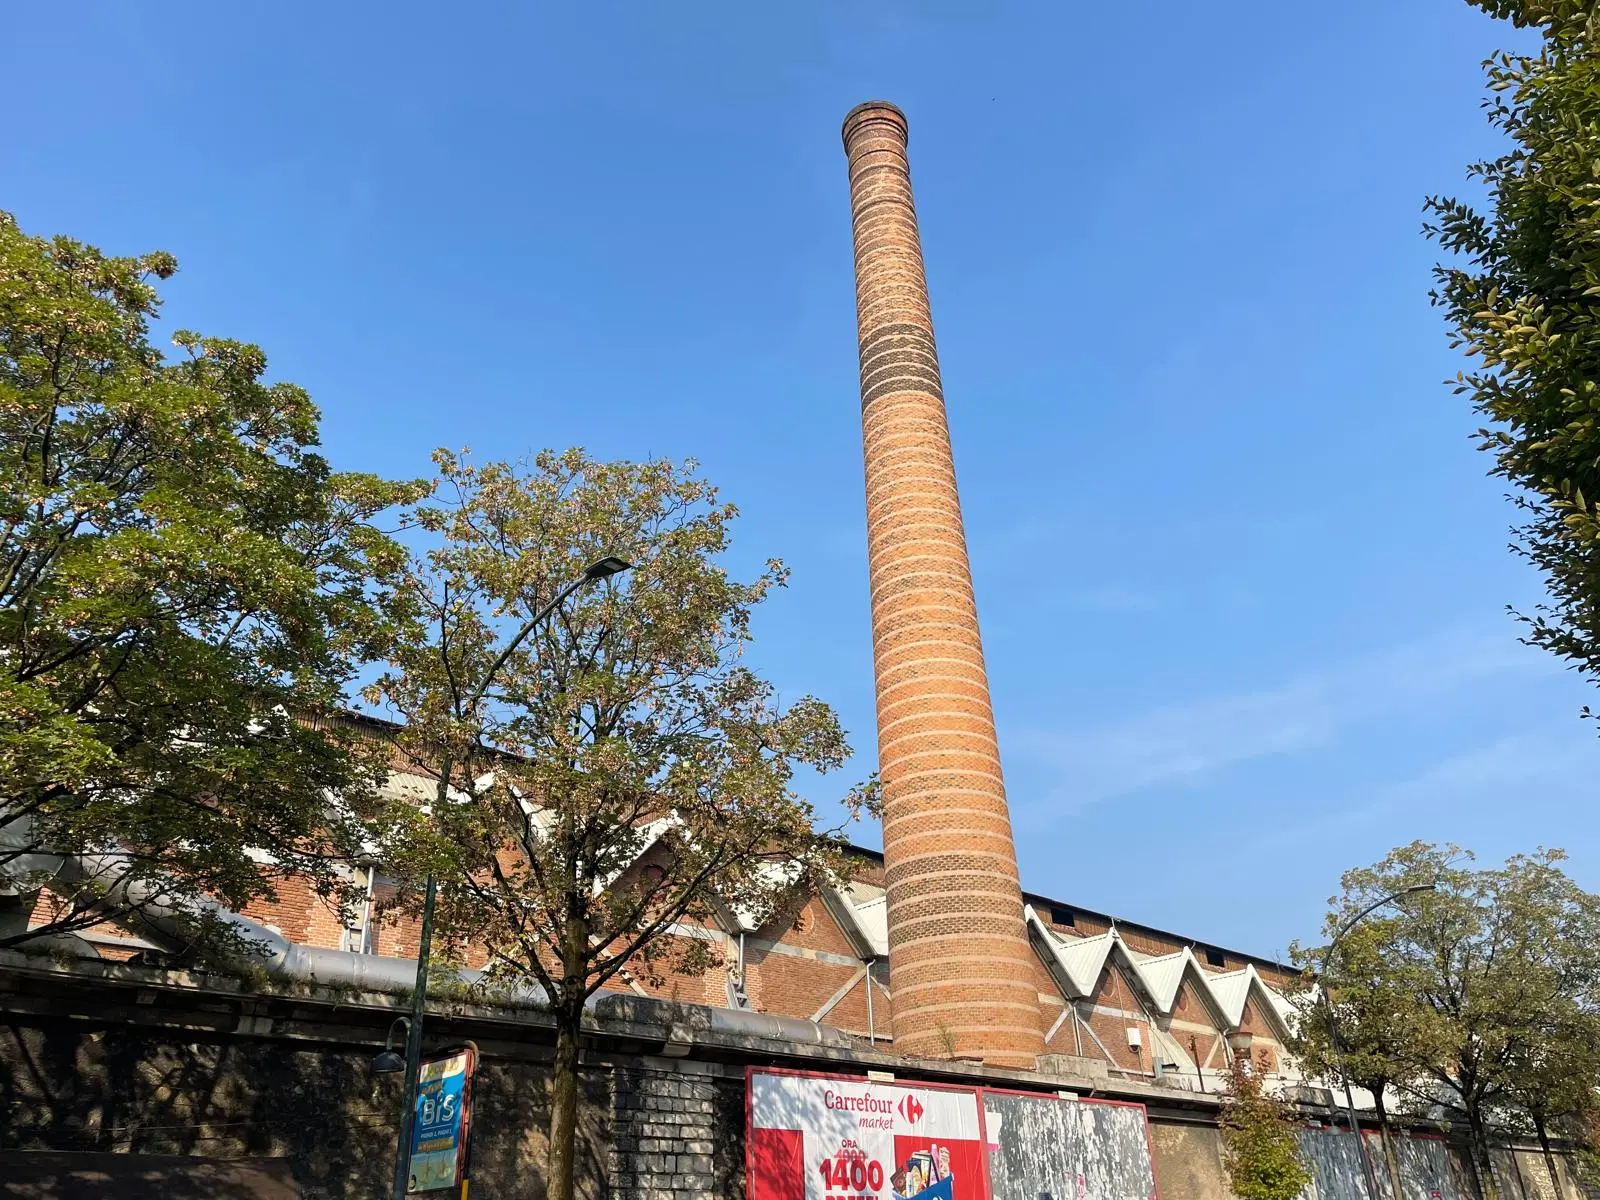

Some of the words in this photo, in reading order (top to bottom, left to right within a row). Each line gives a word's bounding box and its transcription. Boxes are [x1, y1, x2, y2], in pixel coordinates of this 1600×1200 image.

[824, 1090, 892, 1113] Carrefour
[859, 1116, 894, 1130] market
[841, 1139, 857, 1148] ORA
[819, 1158, 884, 1192] 1400
